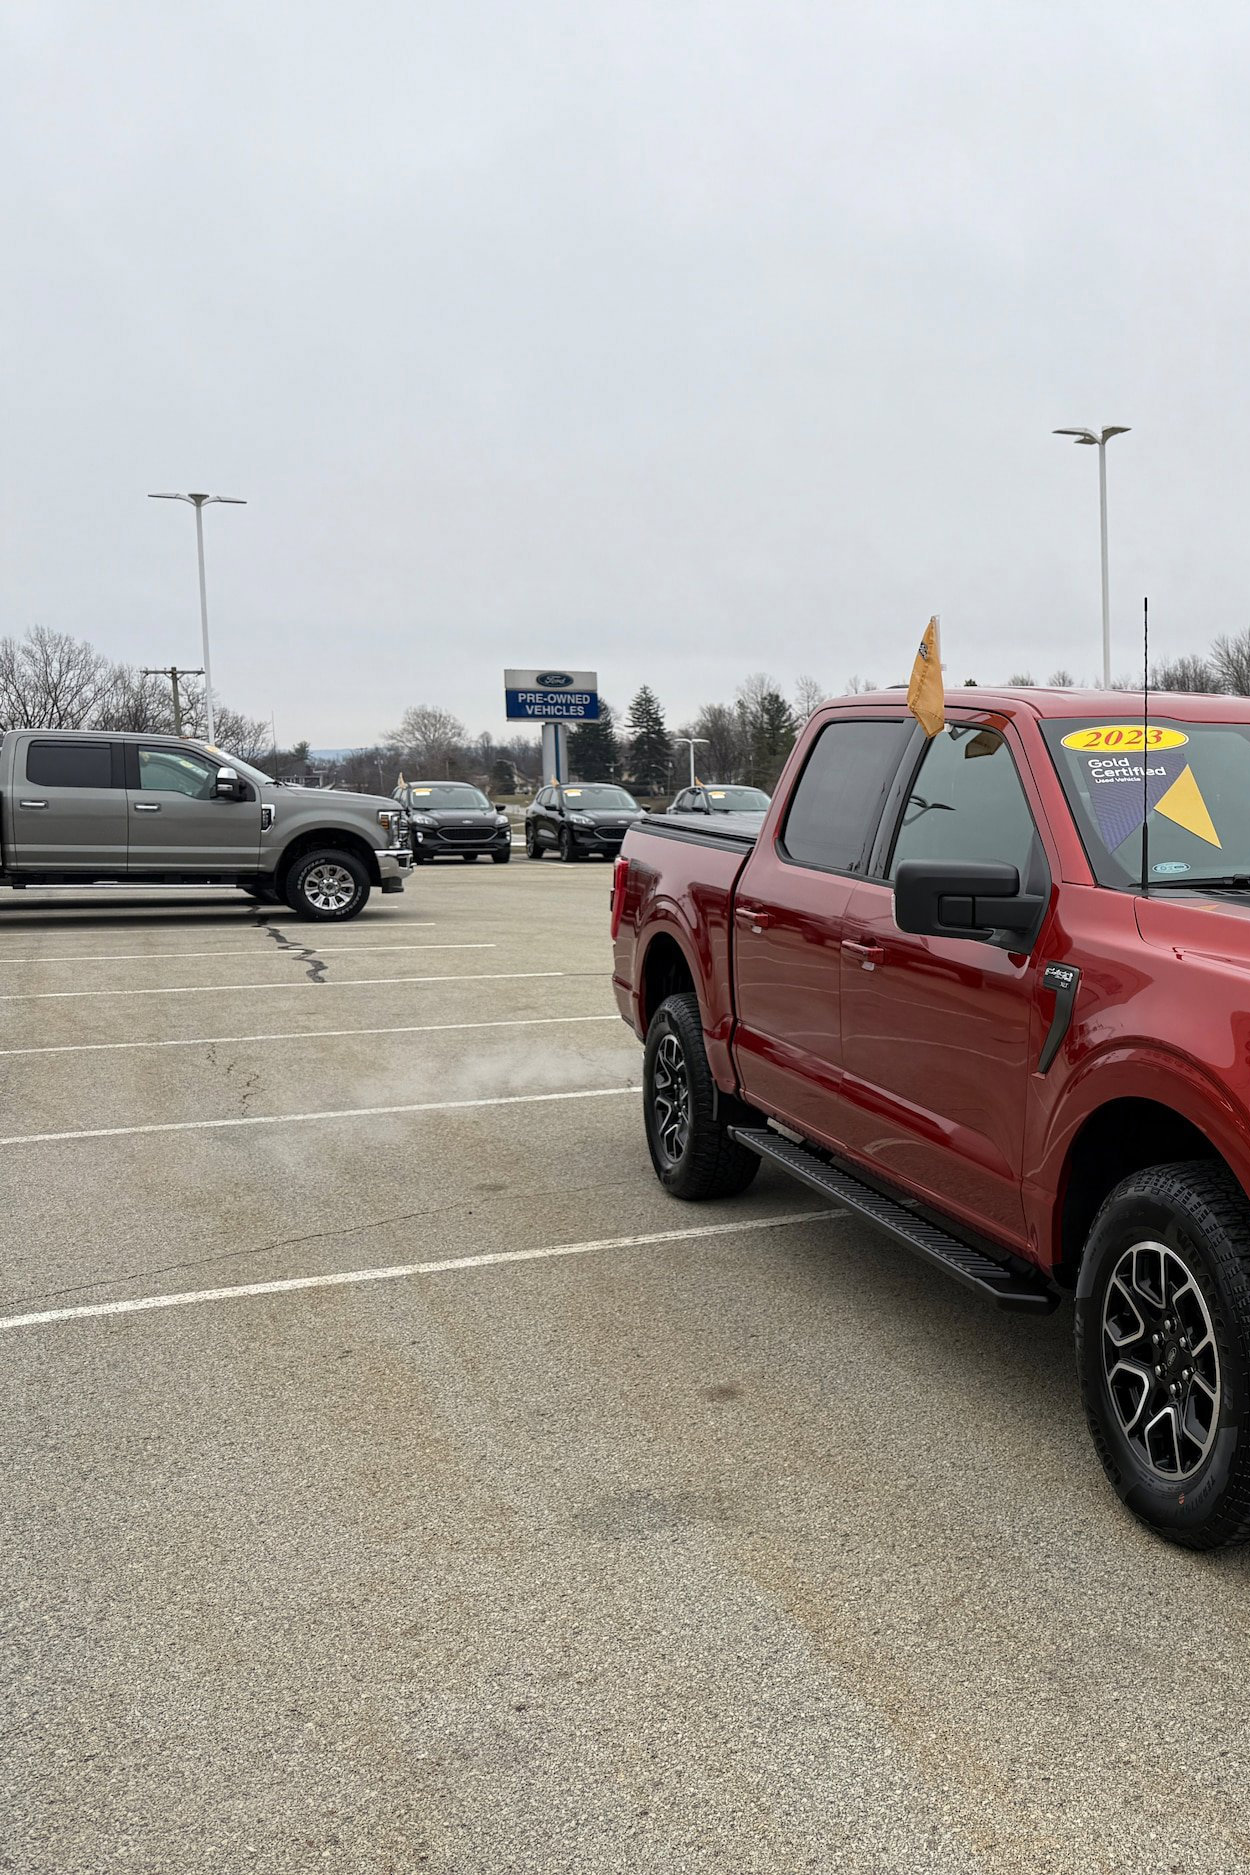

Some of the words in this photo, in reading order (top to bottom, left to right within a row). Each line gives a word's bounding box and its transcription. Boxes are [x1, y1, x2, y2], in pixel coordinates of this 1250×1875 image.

[518, 693, 591, 704] PRE-OWNED
[526, 705, 585, 716] VEHICLES
[1083, 729, 1163, 748] 2023
[1088, 757, 1130, 768] Gold
[1091, 766, 1167, 778] Certified
